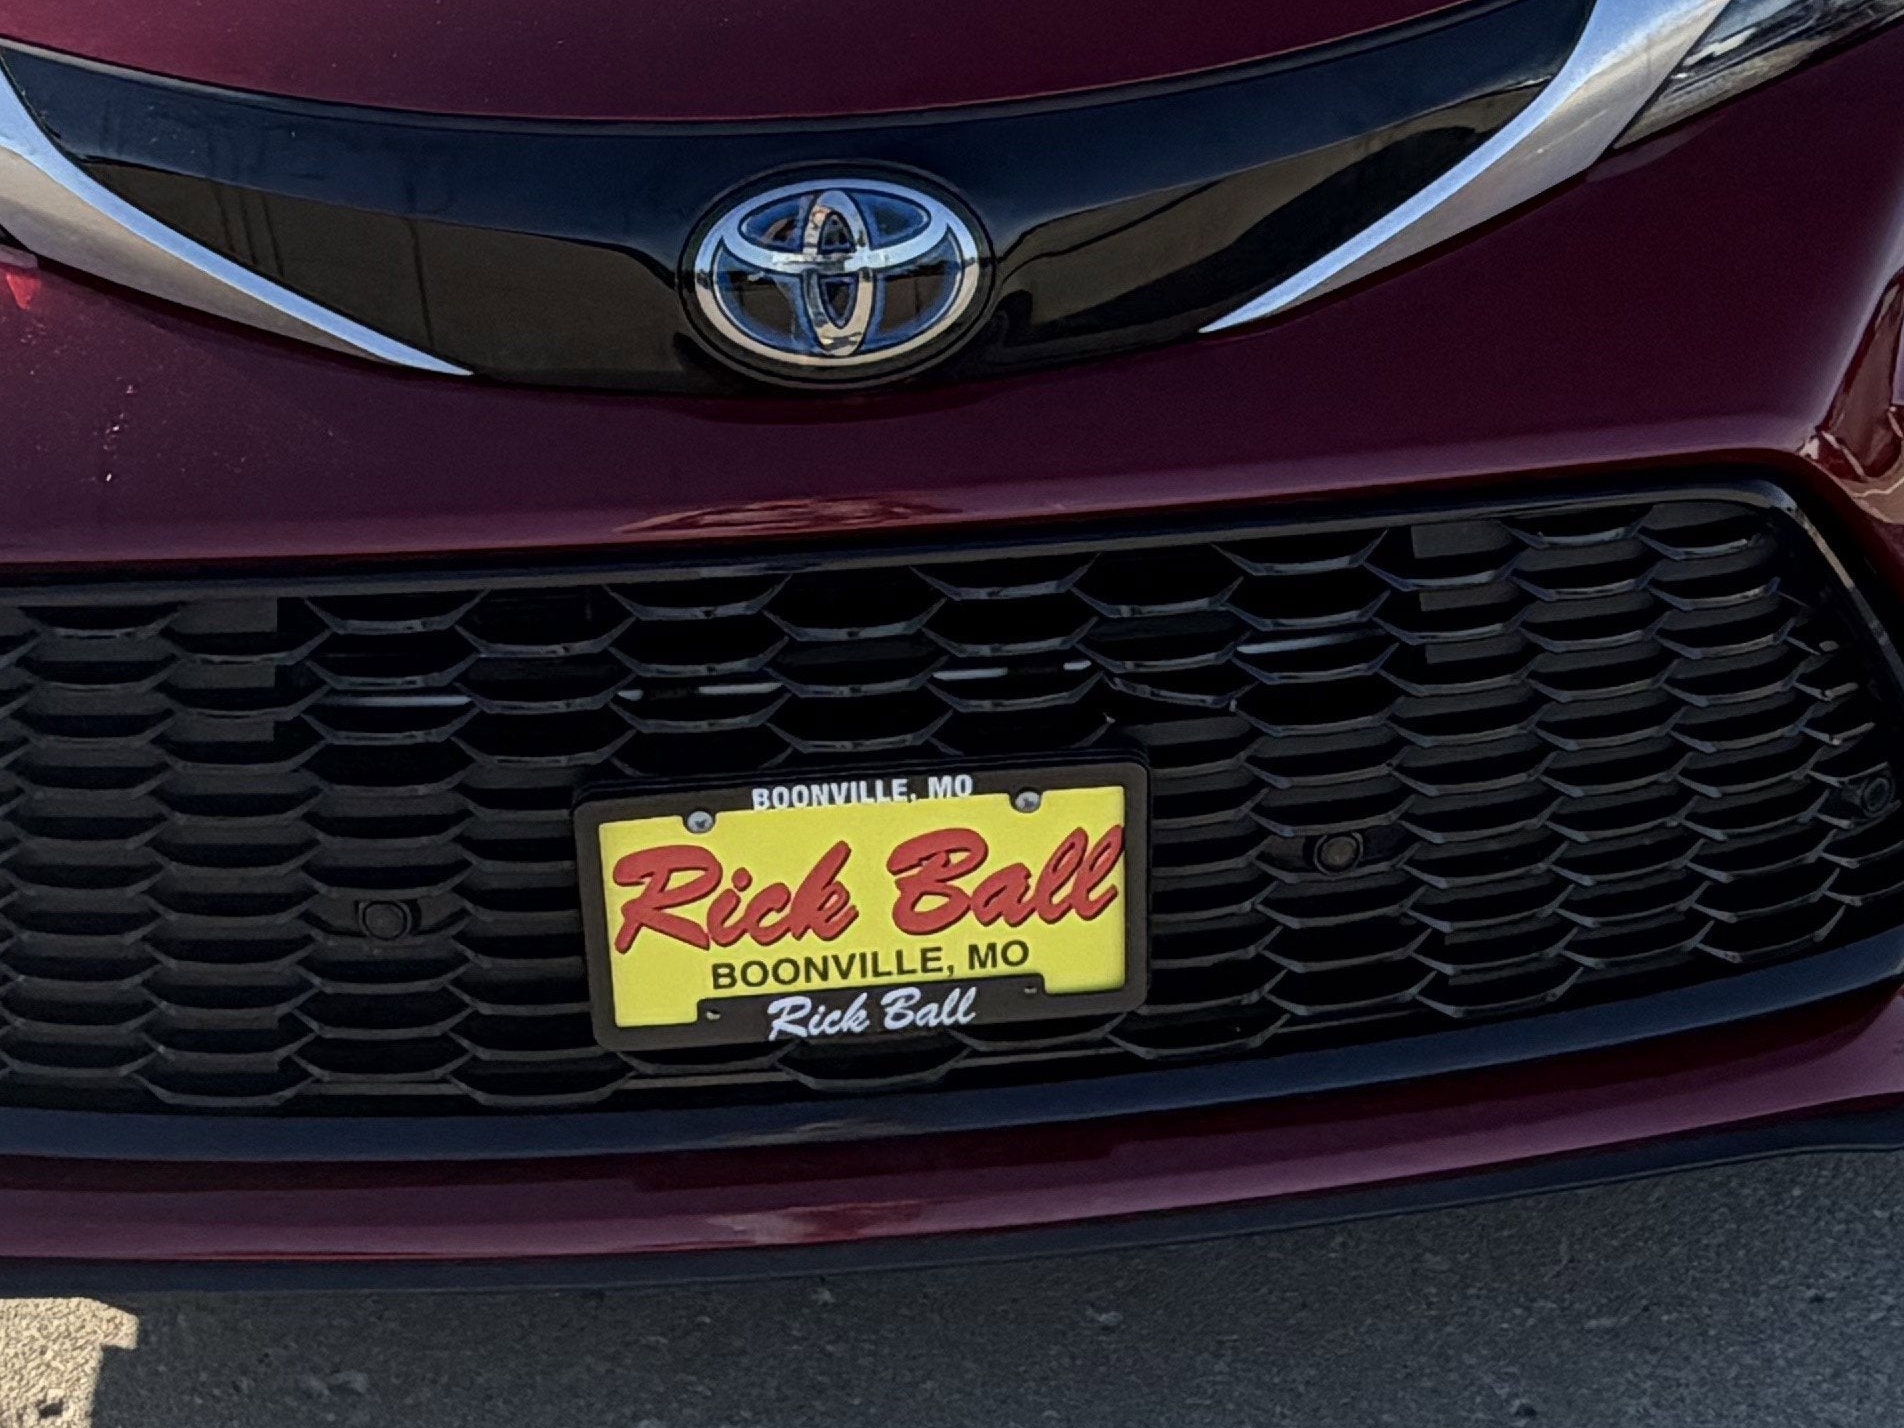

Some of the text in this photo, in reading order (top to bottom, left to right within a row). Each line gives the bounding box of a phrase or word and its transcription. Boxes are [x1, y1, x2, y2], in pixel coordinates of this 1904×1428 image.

[751, 773, 974, 811] BOONVILLE, MO
[613, 824, 1125, 955] Rick Ball
[711, 939, 1030, 991] BOONVILLE, MO
[766, 986, 978, 1042] Rick Ball
